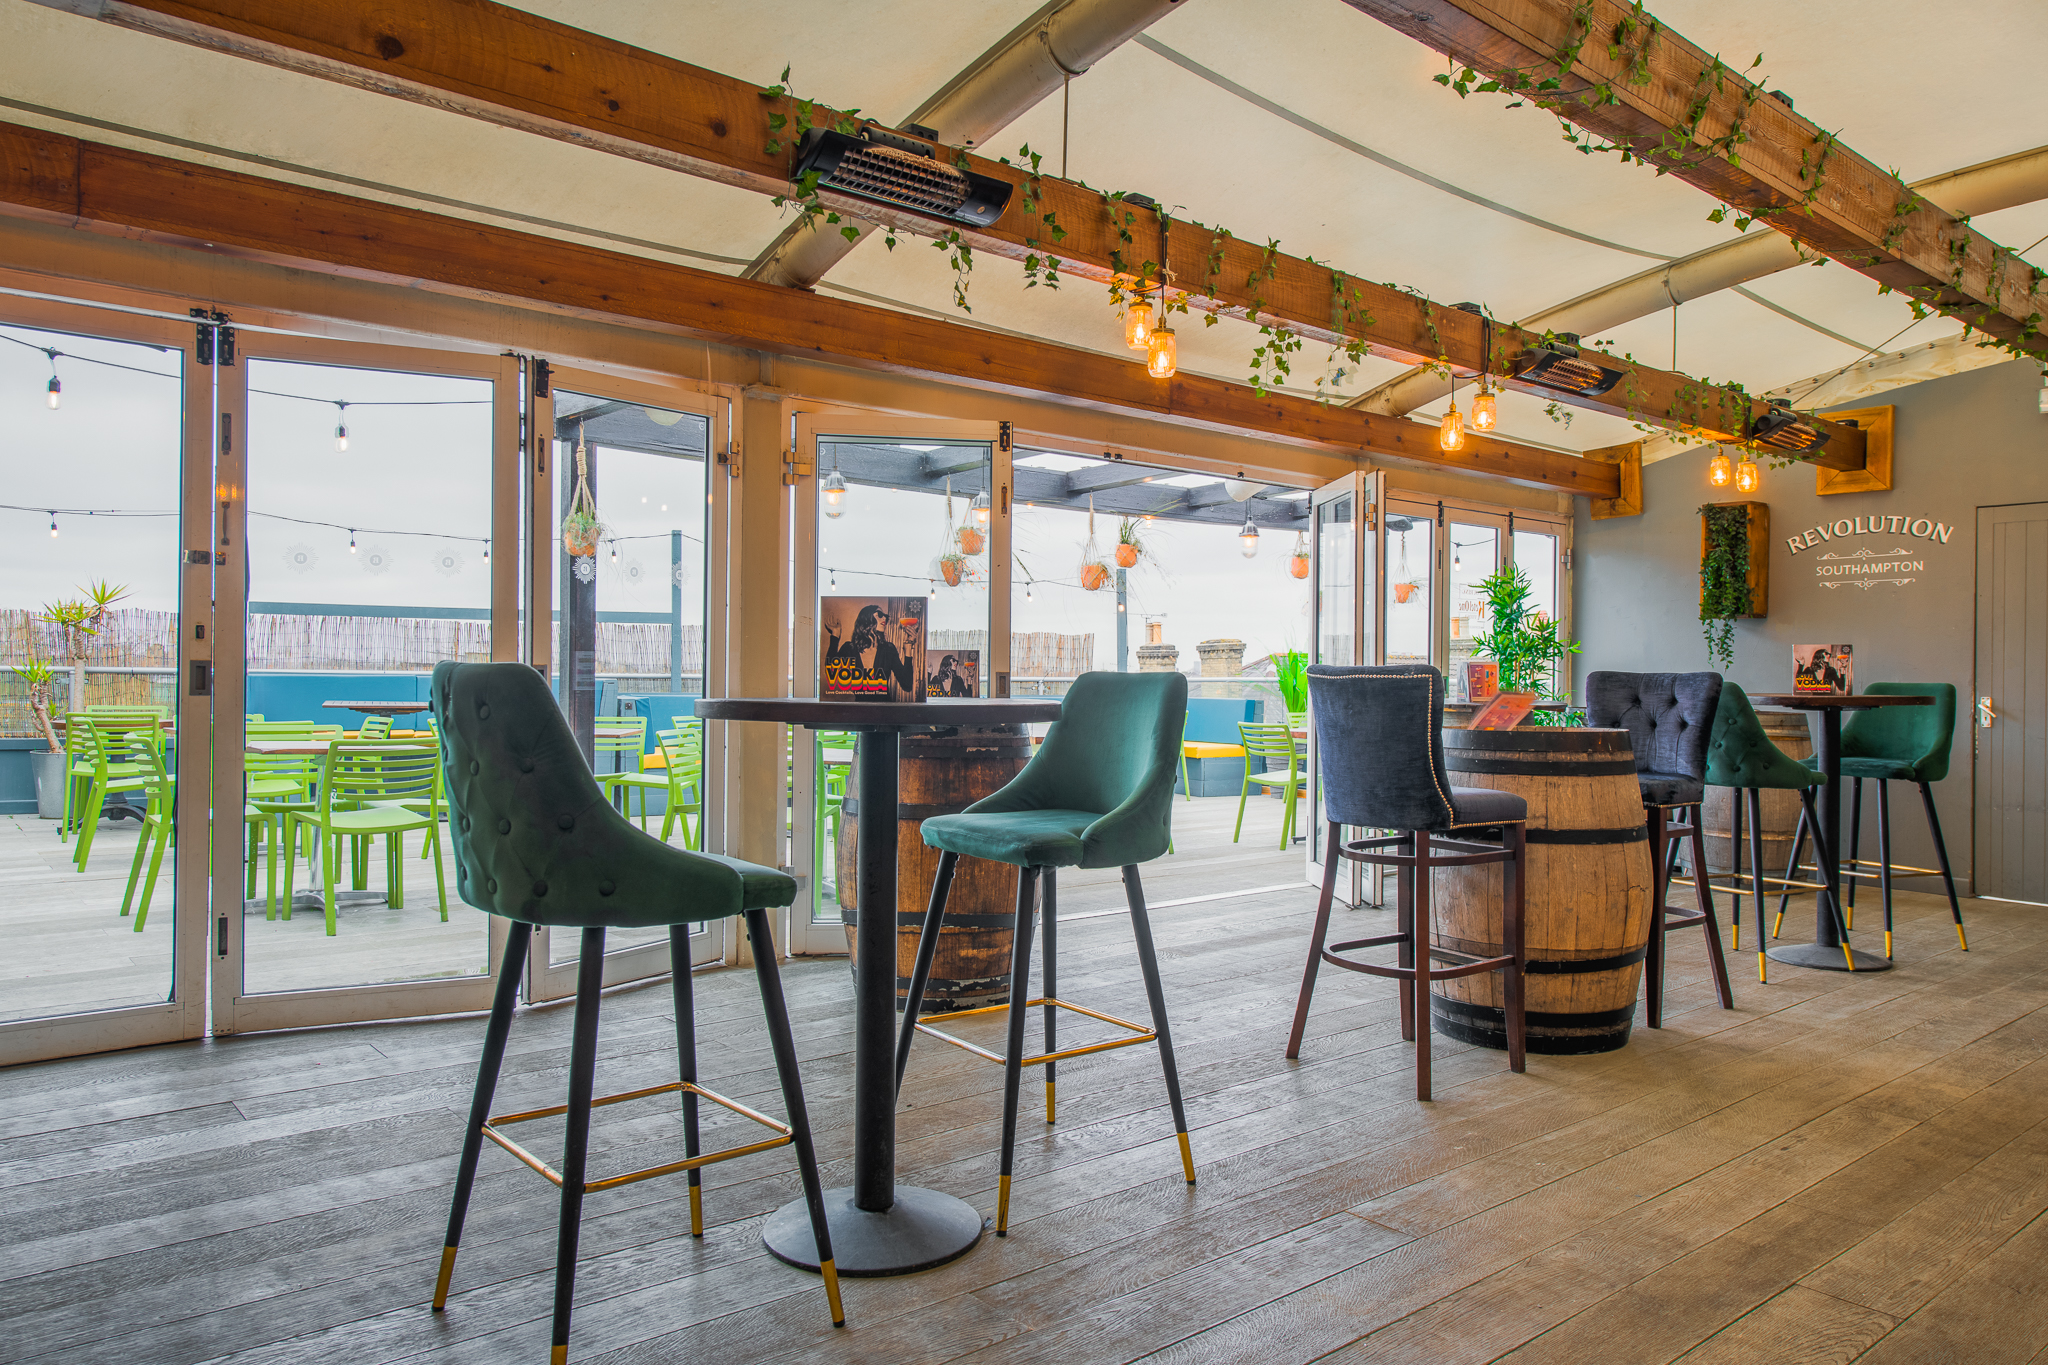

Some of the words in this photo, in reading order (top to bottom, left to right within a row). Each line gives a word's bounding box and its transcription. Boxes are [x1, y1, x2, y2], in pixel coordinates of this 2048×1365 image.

[1786, 515, 1954, 556] REVOLUTION
[1816, 560, 1924, 577] SOUTHAMPTON
[825, 657, 856, 668] LOVE
[825, 667, 888, 690] VODKA
[1795, 679, 1831, 691] VODKA
